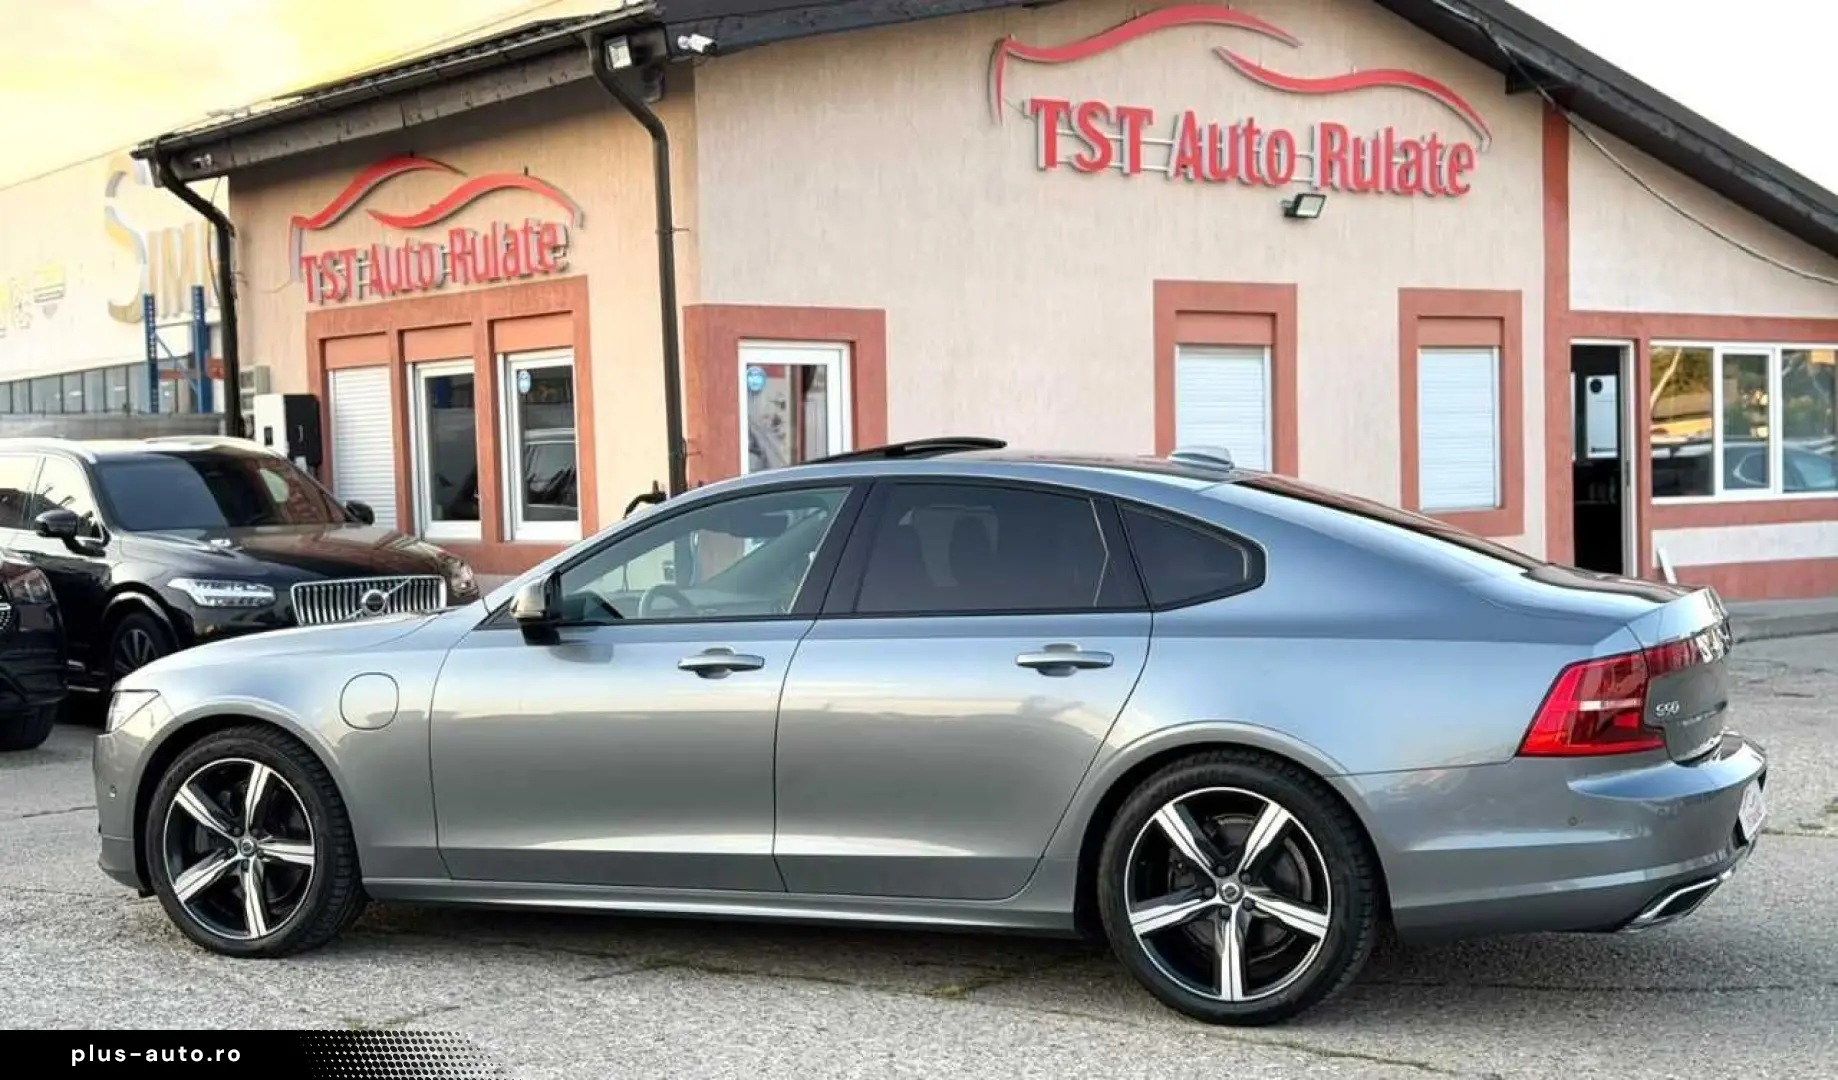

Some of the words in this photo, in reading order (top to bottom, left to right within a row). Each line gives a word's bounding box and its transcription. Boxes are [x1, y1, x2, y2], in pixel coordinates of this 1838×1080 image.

[1031, 98, 1153, 174] TST
[1169, 110, 1297, 185] Auto
[1313, 121, 1476, 196] Rulate
[301, 249, 362, 304] TST
[368, 238, 440, 297] Auto
[448, 218, 567, 284] Rulate
